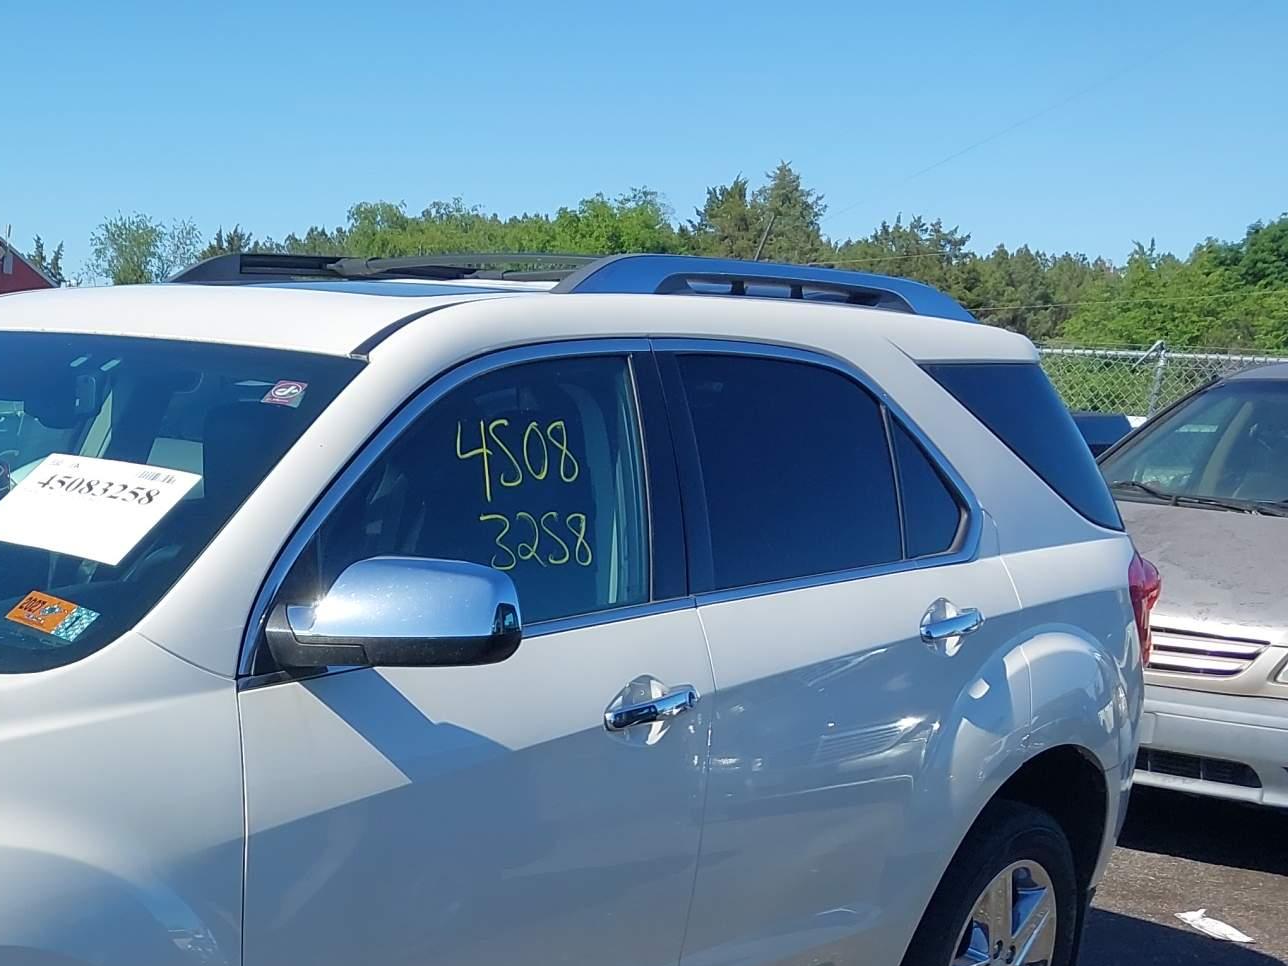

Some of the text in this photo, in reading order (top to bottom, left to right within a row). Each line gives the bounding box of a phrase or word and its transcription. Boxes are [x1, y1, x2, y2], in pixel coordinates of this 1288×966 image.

[37, 473, 161, 506] 45083258
[455, 419, 580, 502] 4508
[478, 512, 593, 571] 3258
